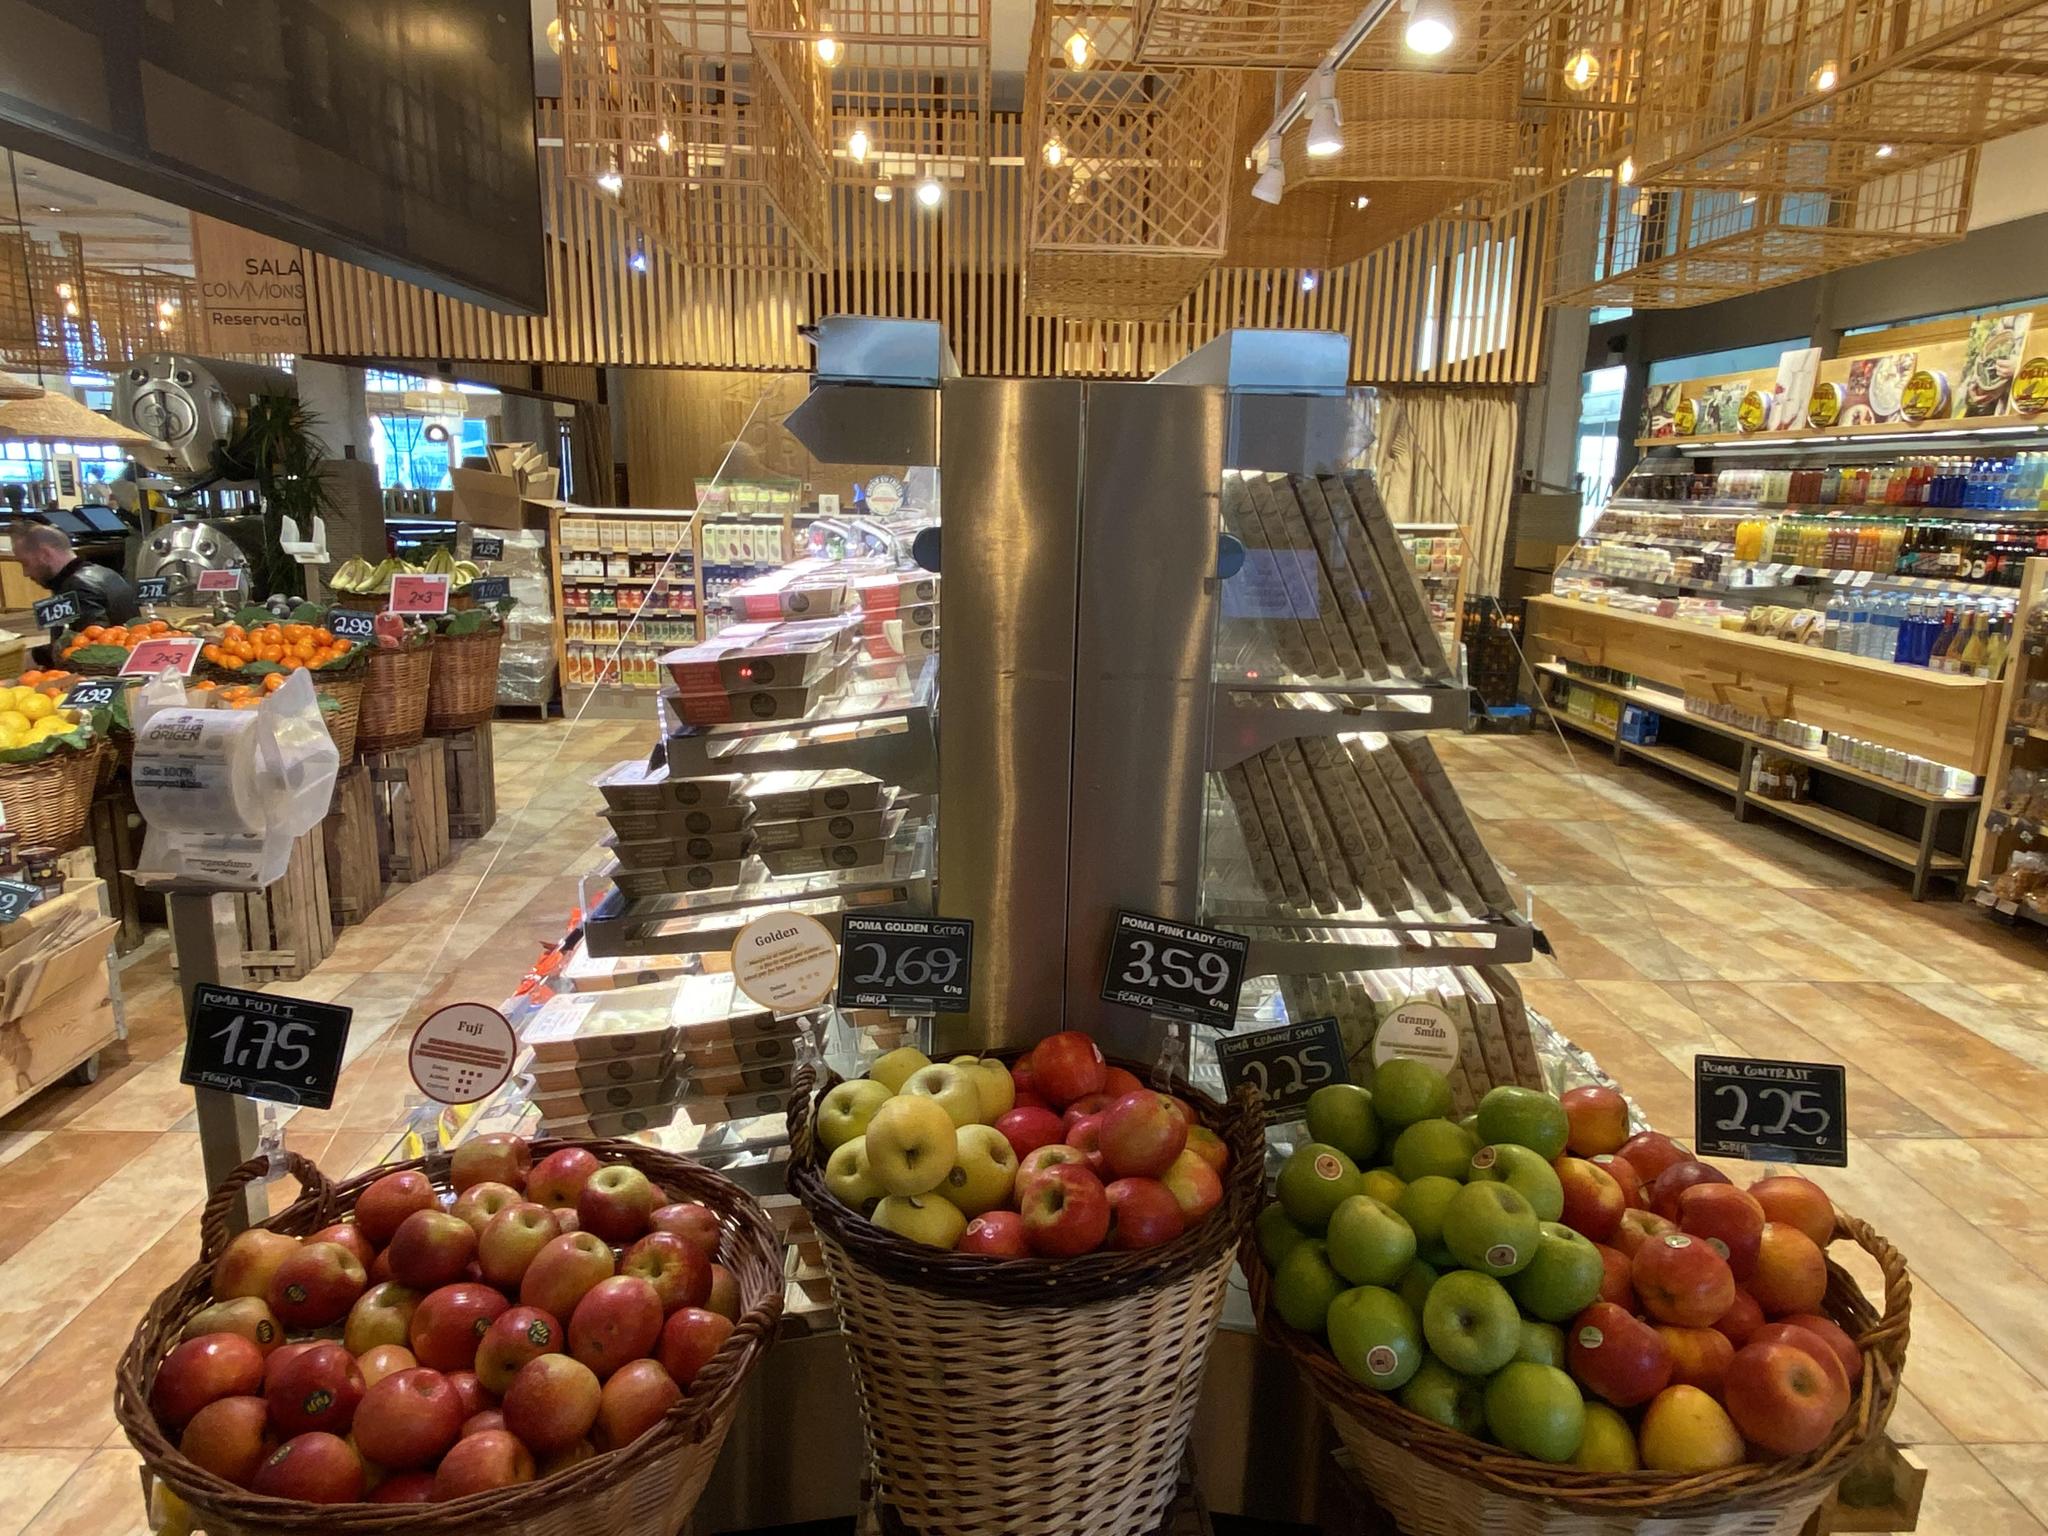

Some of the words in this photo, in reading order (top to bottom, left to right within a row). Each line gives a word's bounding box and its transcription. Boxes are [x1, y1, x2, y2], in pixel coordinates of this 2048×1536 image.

[245, 258, 303, 276] SALA
[202, 280, 304, 300] COMMONS
[150, 730, 201, 741] ORIGEN
[849, 920, 882, 931] POMA
[884, 922, 928, 933] GOLDEN
[1122, 916, 1155, 932] POMA
[1157, 925, 1184, 938] PINK
[1186, 930, 1216, 944] LADY
[755, 926, 799, 947] Golden
[202, 992, 240, 1005] POMA
[245, 999, 277, 1016] FUJI
[457, 1020, 484, 1036] Fuji
[1397, 1013, 1437, 1027] Granny
[1414, 1026, 1446, 1038] Smith
[1744, 1065, 1813, 1080] CONTRAST
